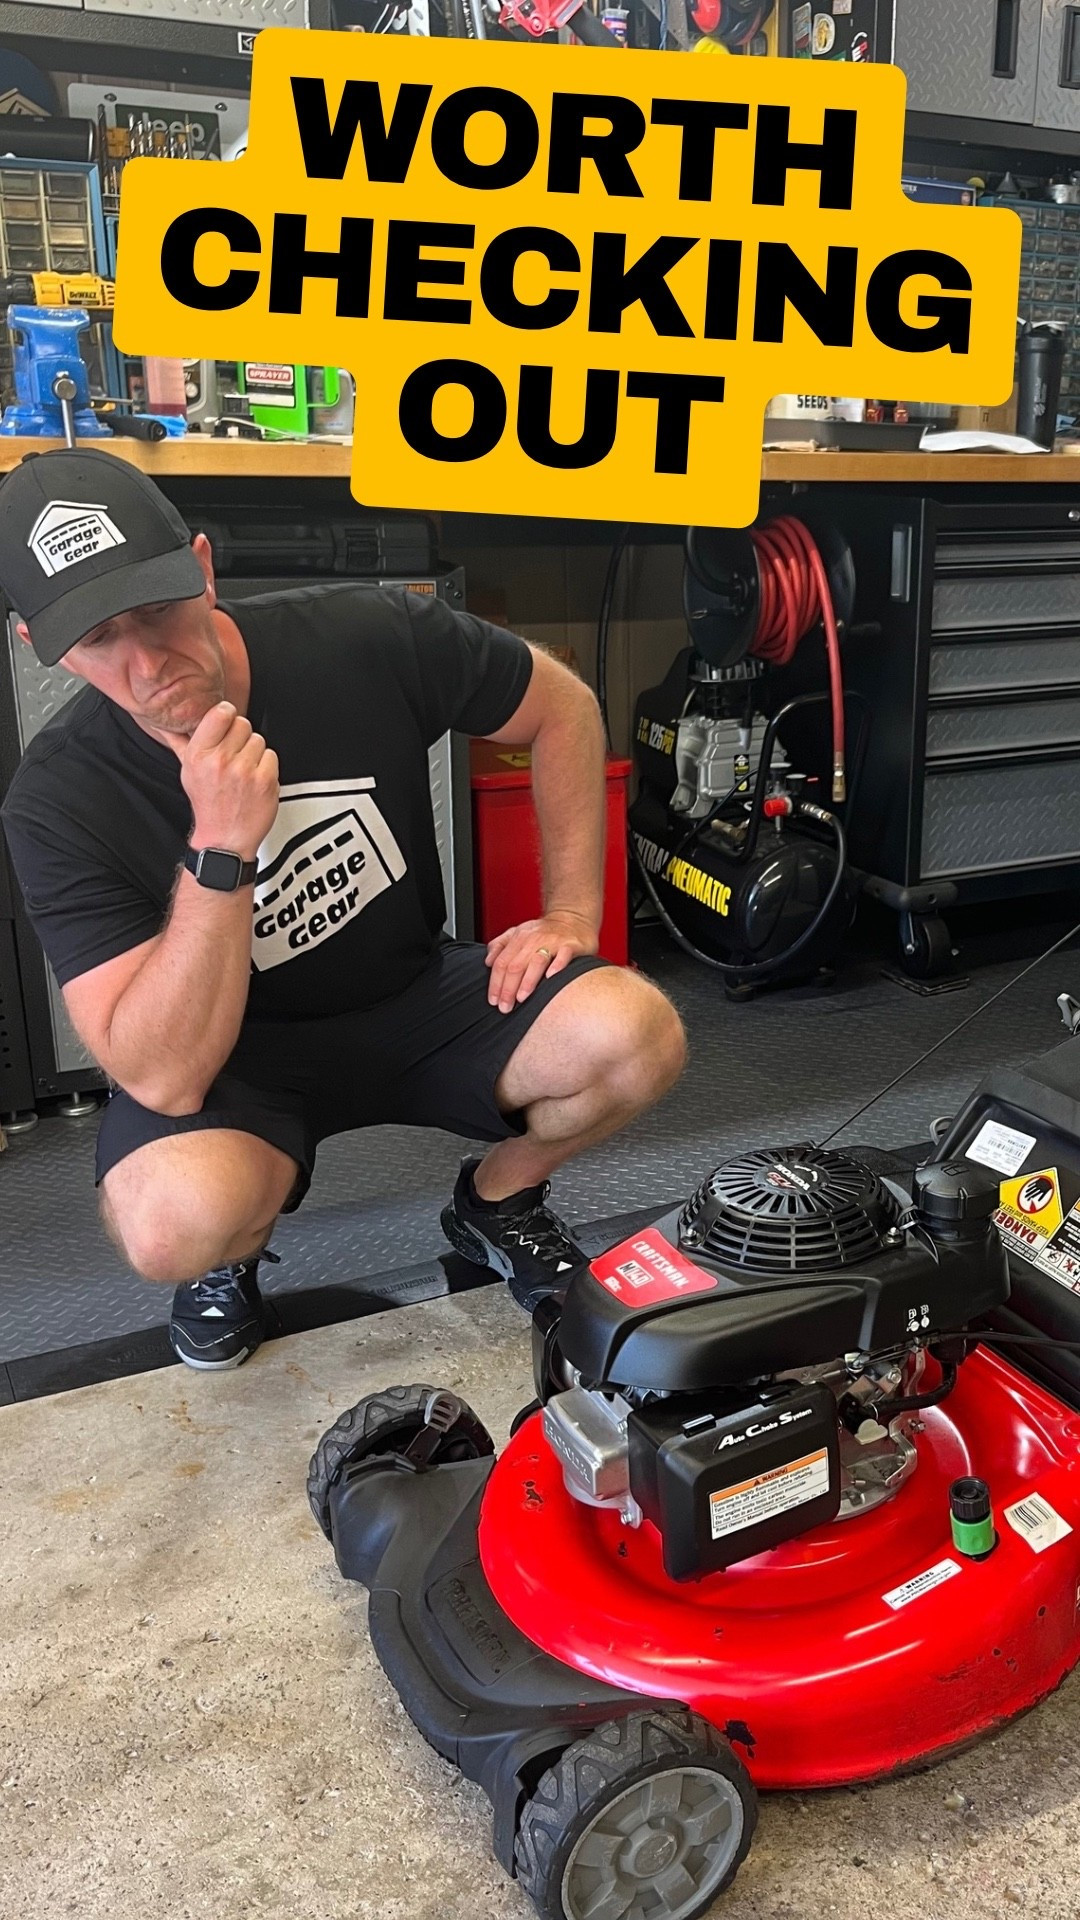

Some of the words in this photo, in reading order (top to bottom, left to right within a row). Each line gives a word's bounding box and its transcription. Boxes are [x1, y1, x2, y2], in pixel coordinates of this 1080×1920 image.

[249, 370, 290, 380] SPRAYER
[797, 394, 829, 410] SEEDS
[49, 526, 102, 556] Garage
[64, 540, 99, 563] Gear
[254, 850, 366, 939] Garage
[666, 855, 731, 917] PNEUMATIC
[288, 886, 360, 949] Gear
[632, 1240, 689, 1290] CRAFTSMAN
[718, 1434, 745, 1450] Auto
[746, 1422, 778, 1437] Choke
[779, 1408, 813, 1425] System
[762, 1466, 788, 1482] WARNING
[905, 1571, 935, 1589] WARNING
